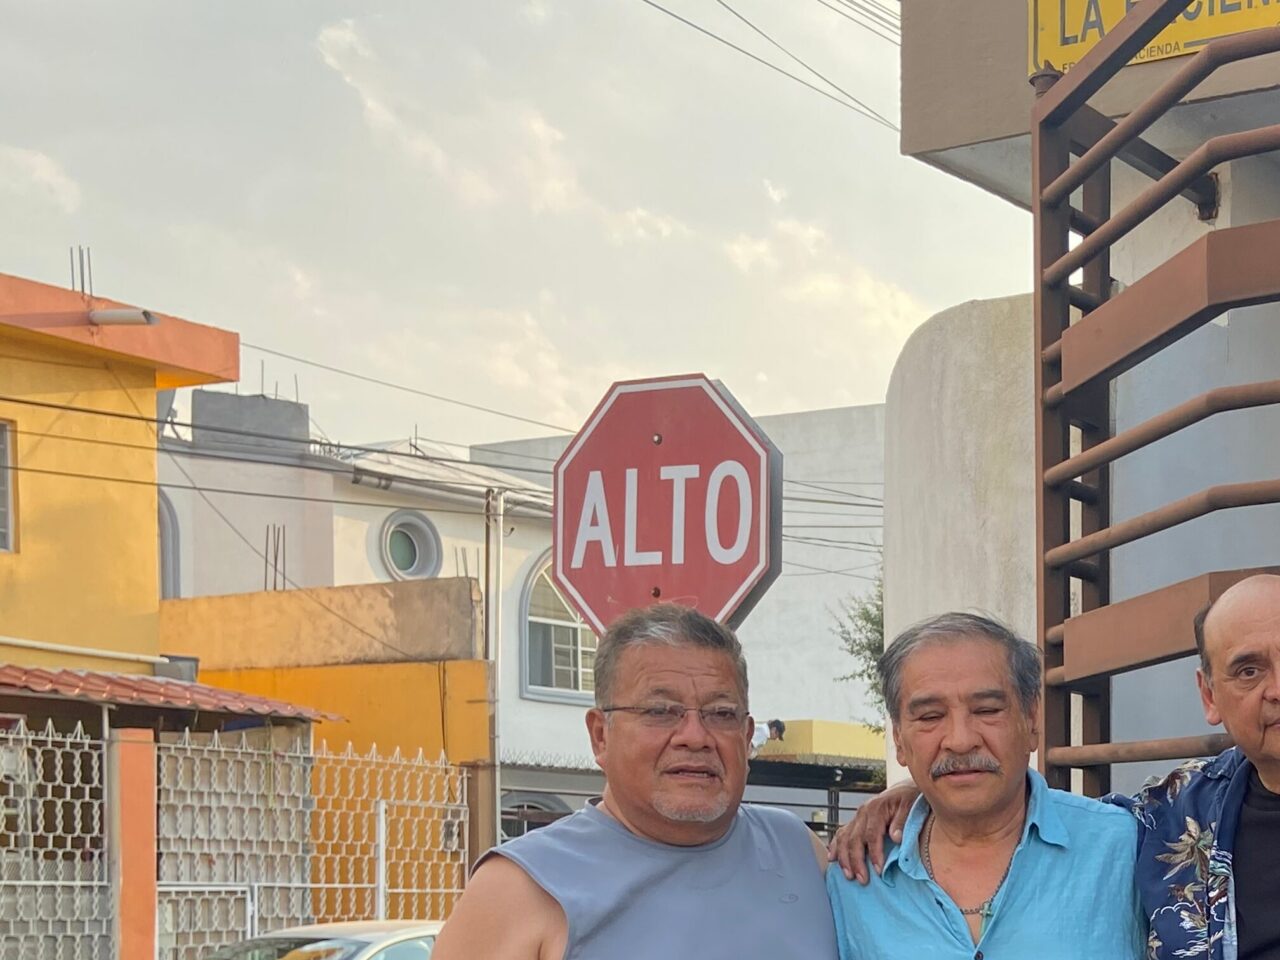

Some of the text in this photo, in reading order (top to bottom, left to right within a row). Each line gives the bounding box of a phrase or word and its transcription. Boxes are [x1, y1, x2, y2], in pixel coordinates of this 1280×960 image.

[1060, 0, 1106, 46] LA
[1136, 41, 1181, 59] CIENDA
[570, 460, 753, 569] ALTO
